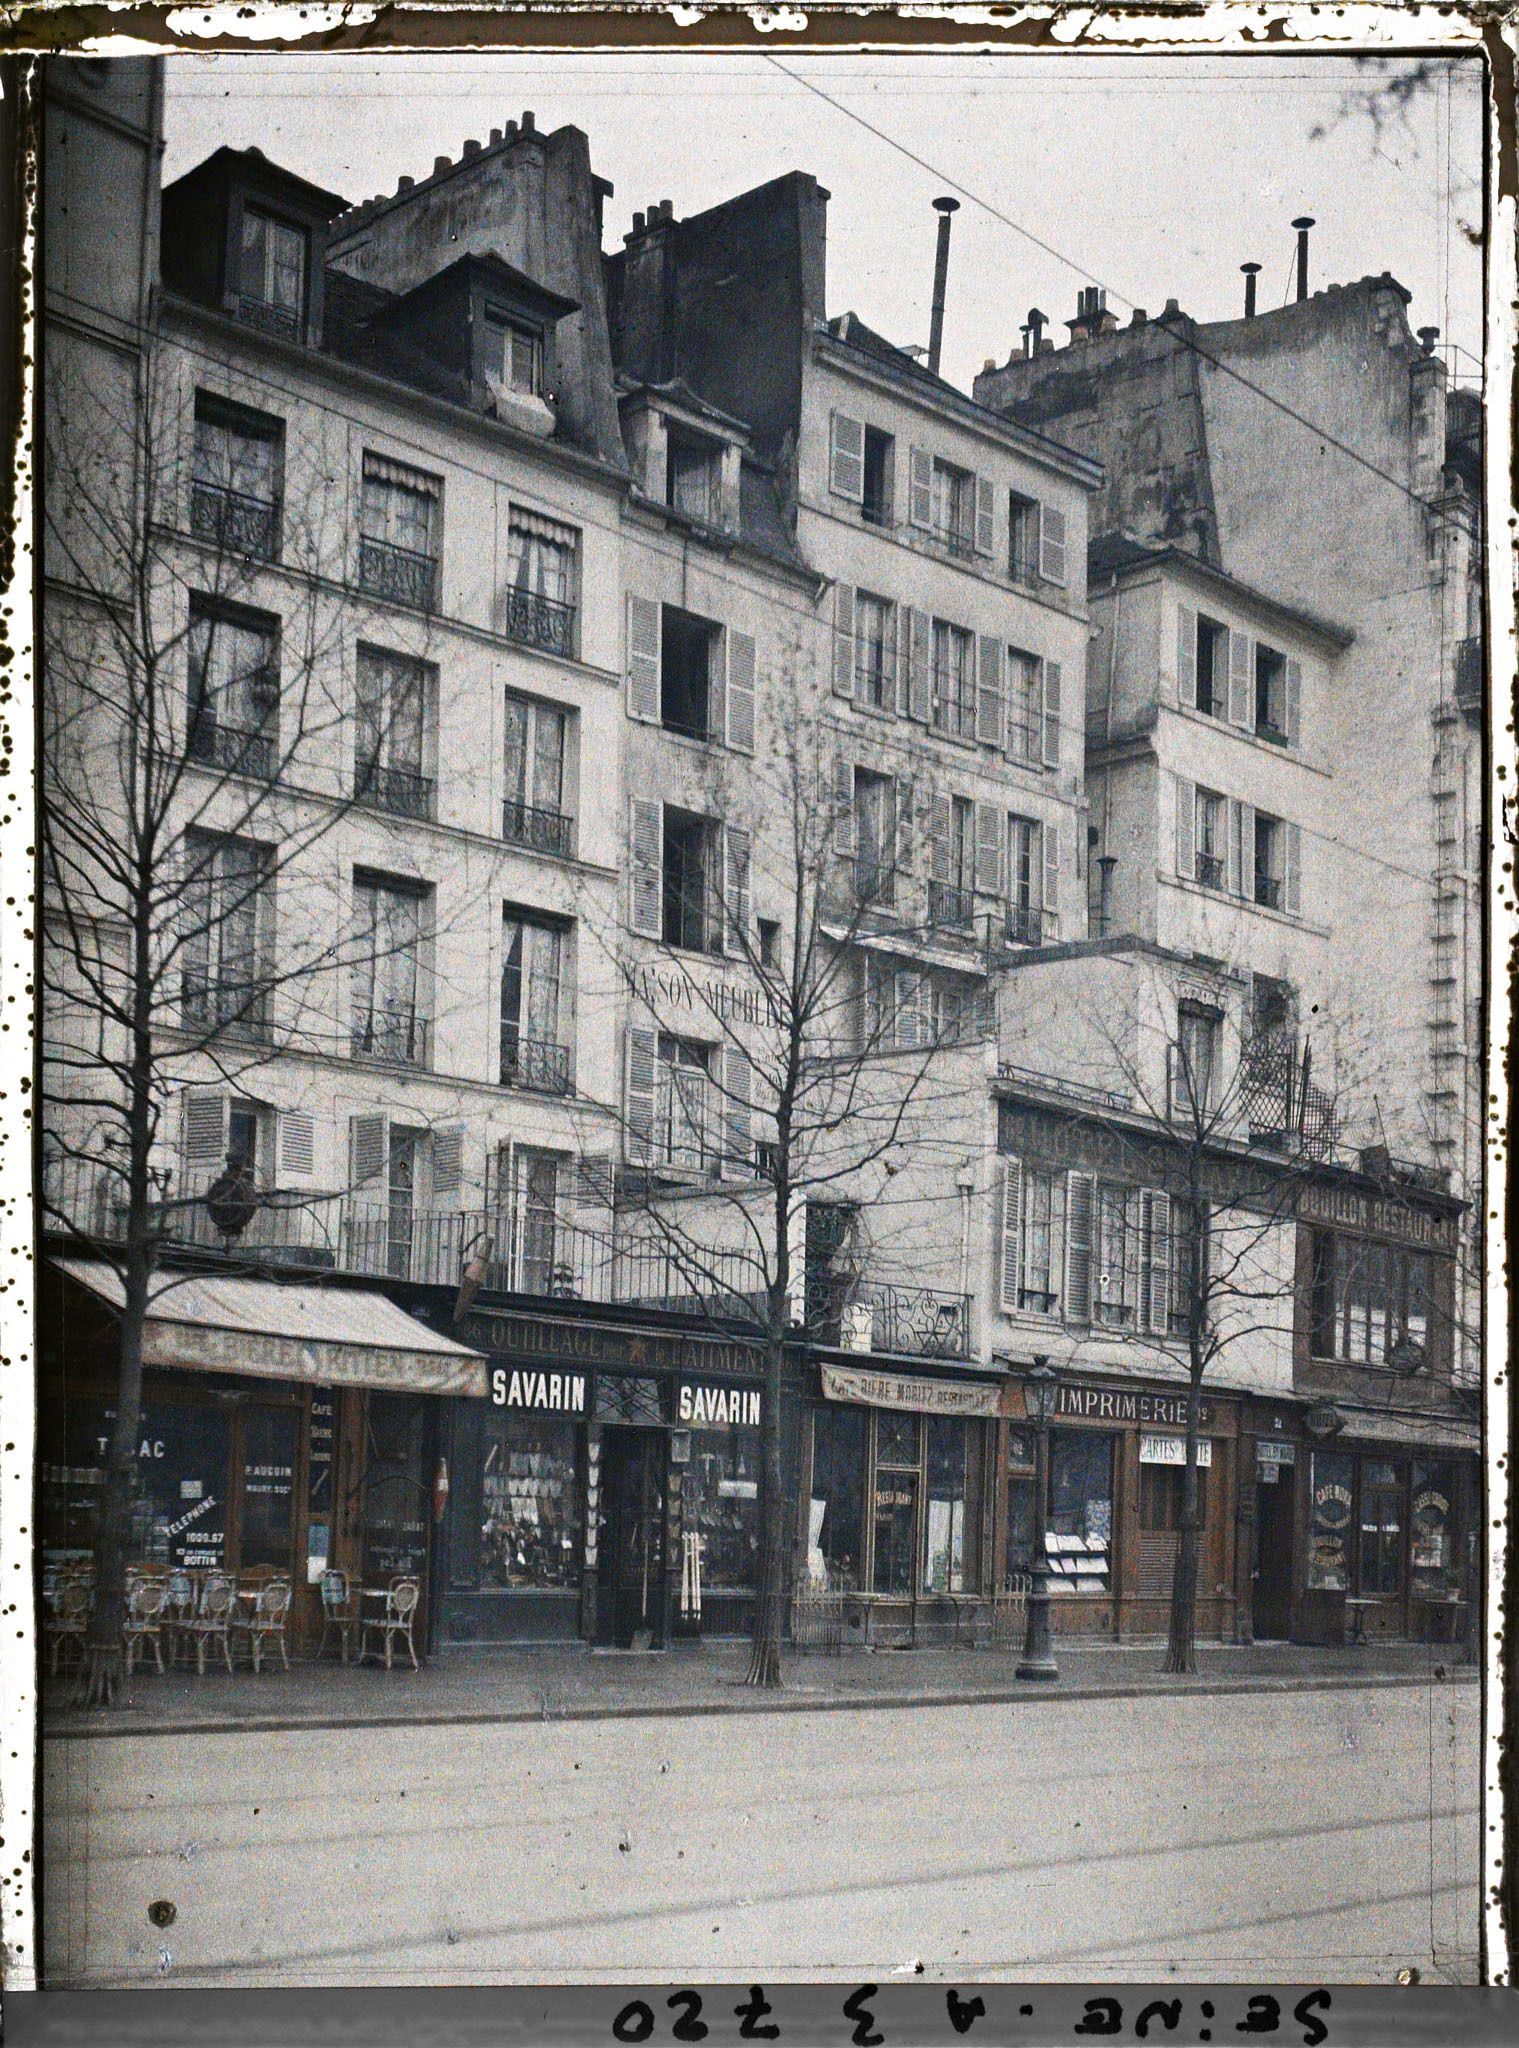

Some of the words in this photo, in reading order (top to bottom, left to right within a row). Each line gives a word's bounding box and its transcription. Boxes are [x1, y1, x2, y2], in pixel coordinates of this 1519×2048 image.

[493, 1369, 585, 1411] SAVARIN
[679, 1386, 760, 1425] SAVARIN
[1060, 1388, 1188, 1424] IMPRIMERIE
[97, 1437, 165, 1458] TAC
[161, 1495, 216, 1538] TELEPHONE
